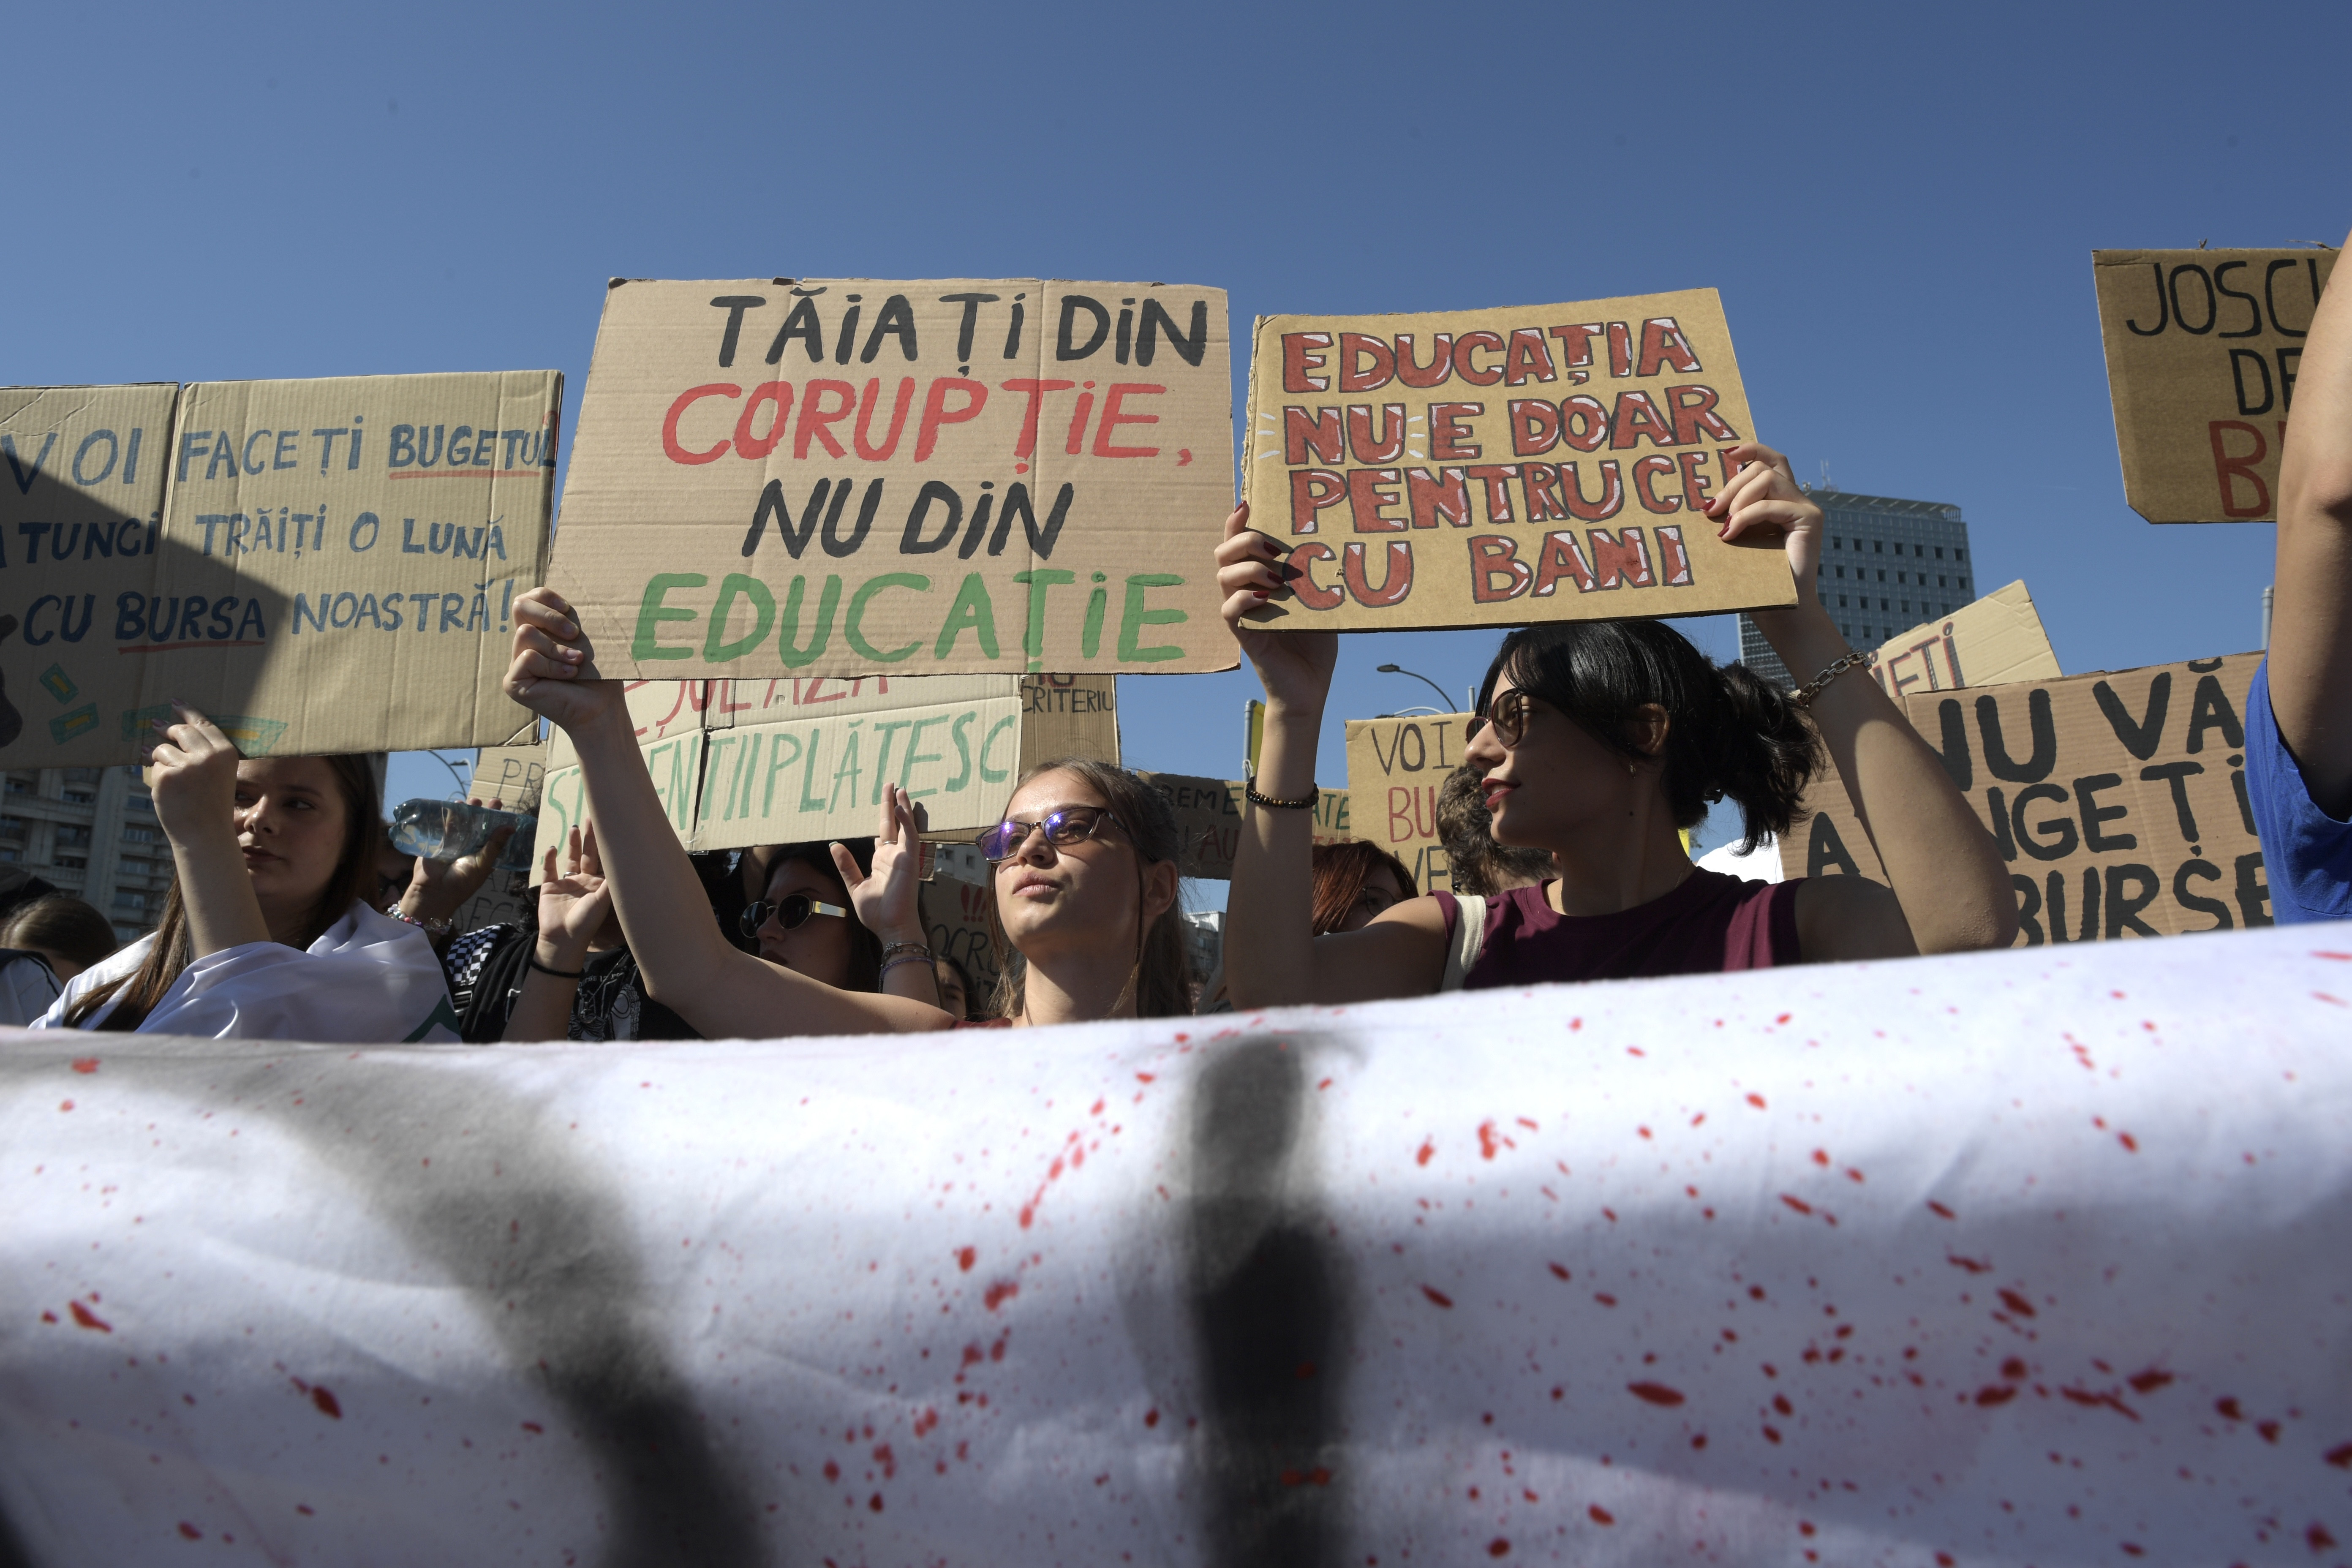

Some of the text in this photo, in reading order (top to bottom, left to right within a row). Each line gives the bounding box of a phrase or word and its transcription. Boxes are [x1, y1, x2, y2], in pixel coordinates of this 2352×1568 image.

[1283, 384, 1740, 466] NU E DOAR
[1, 428, 142, 495] VOI
[1289, 459, 1624, 535] PENTRU
[349, 512, 380, 552] O
[741, 478, 885, 560] NU
[1285, 525, 1694, 610] CU BANI
[23, 593, 96, 646] CU
[115, 591, 266, 642] BURSA
[1371, 721, 1455, 776] VOI
